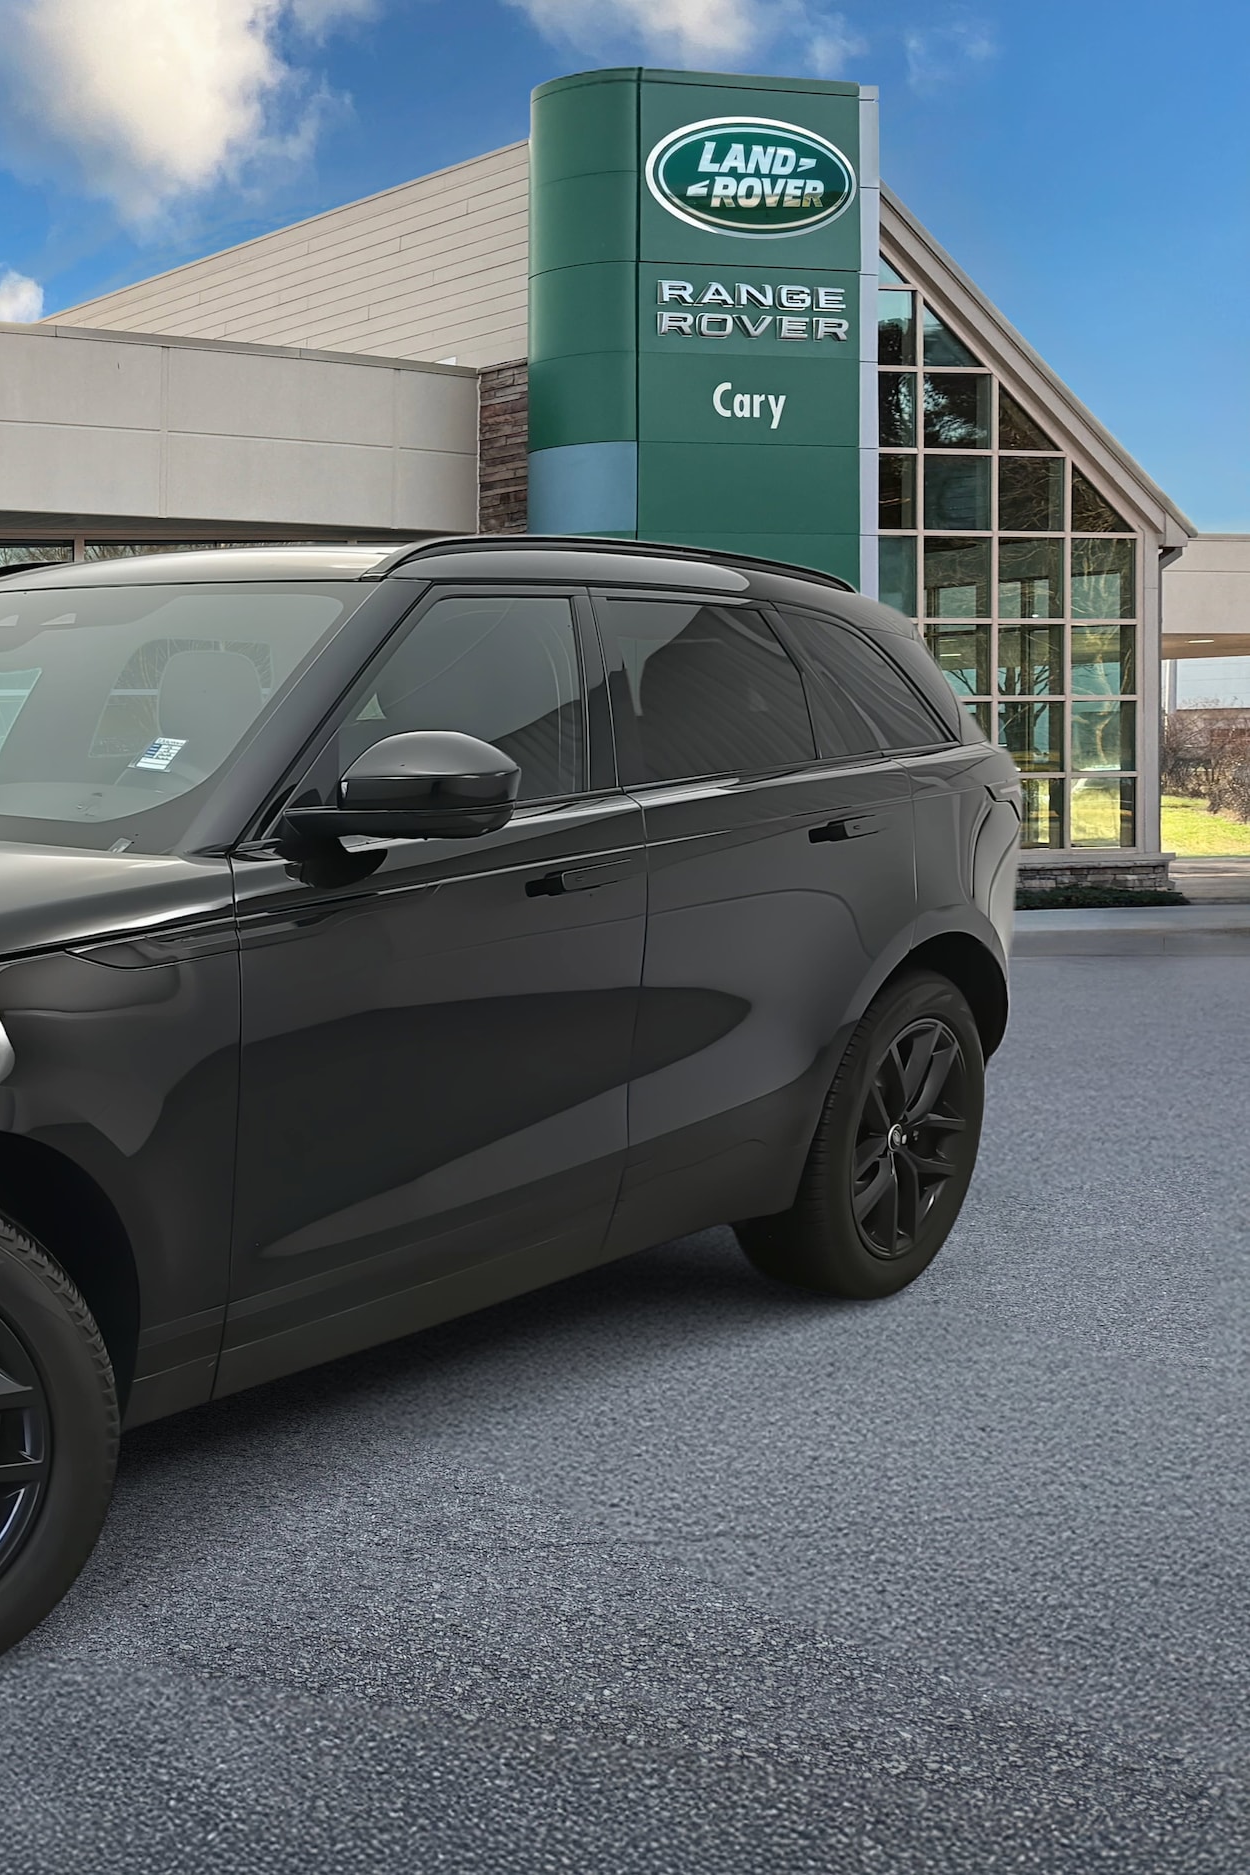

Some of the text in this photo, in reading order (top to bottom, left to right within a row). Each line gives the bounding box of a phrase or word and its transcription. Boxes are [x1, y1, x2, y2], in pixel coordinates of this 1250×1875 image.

[697, 141, 797, 176] LAND
[710, 176, 825, 208] ROVER
[657, 279, 847, 312] RANGE
[657, 311, 850, 343] ROVER
[712, 382, 787, 430] Cary
